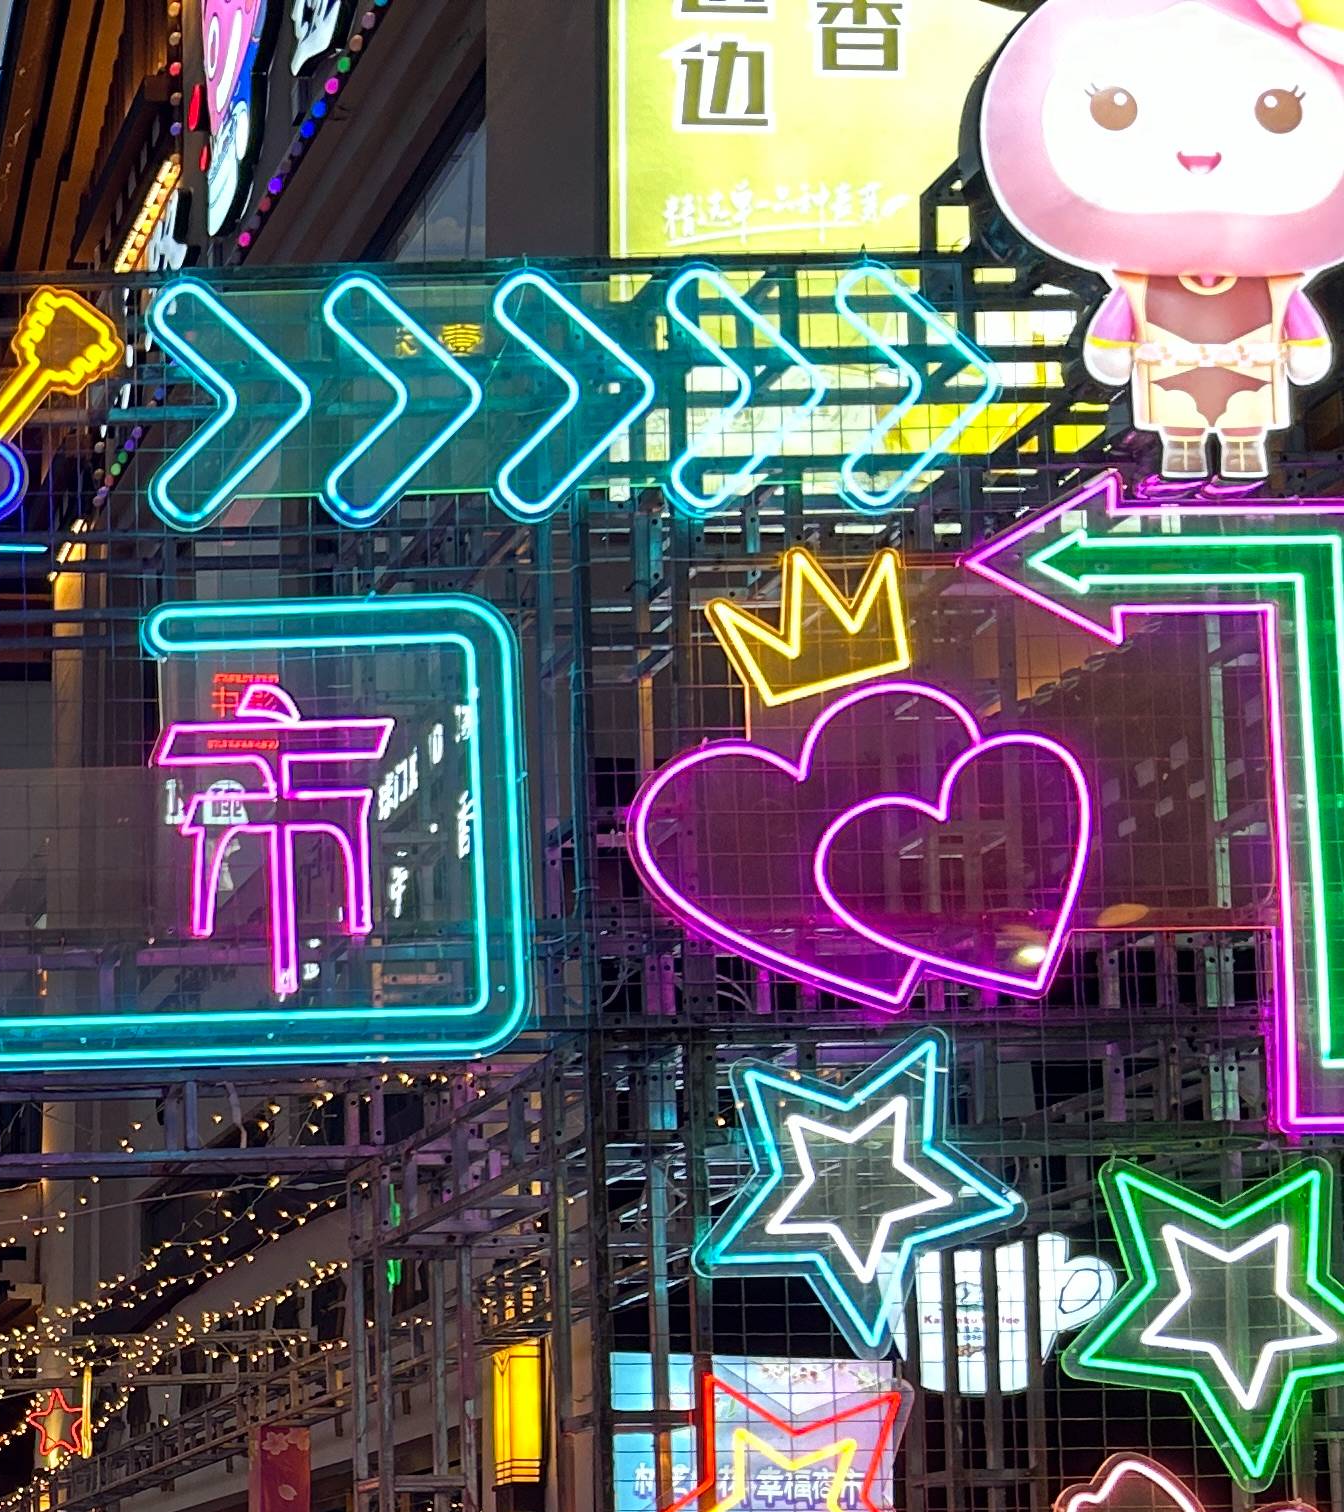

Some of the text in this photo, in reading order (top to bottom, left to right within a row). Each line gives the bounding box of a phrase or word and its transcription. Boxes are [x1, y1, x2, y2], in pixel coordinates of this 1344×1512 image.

[680, 0, 769, 126] 边
[634, 1462, 750, 1507] 林芝花
